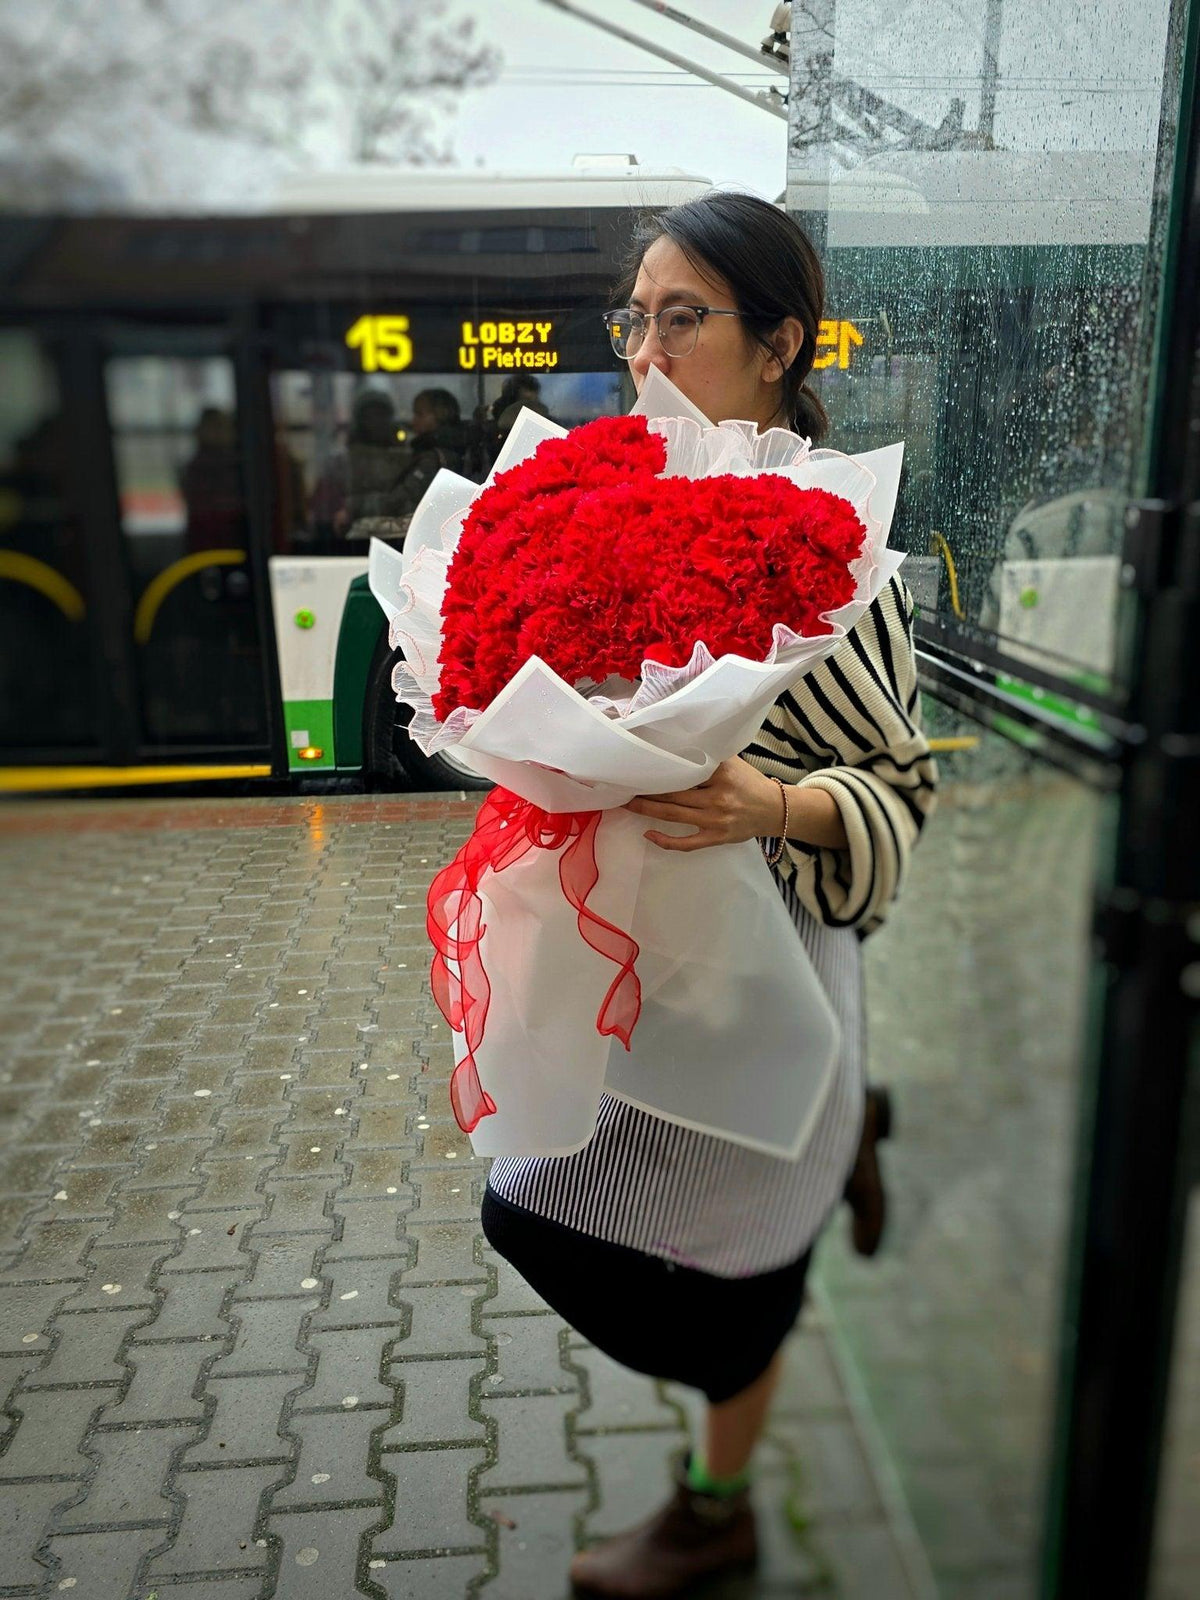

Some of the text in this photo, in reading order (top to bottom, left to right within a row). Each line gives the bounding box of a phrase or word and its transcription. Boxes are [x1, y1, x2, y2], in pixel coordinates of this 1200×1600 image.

[345, 314, 413, 372] 15
[461, 321, 552, 345] LOBZY
[458, 346, 558, 369] U Pietasu
